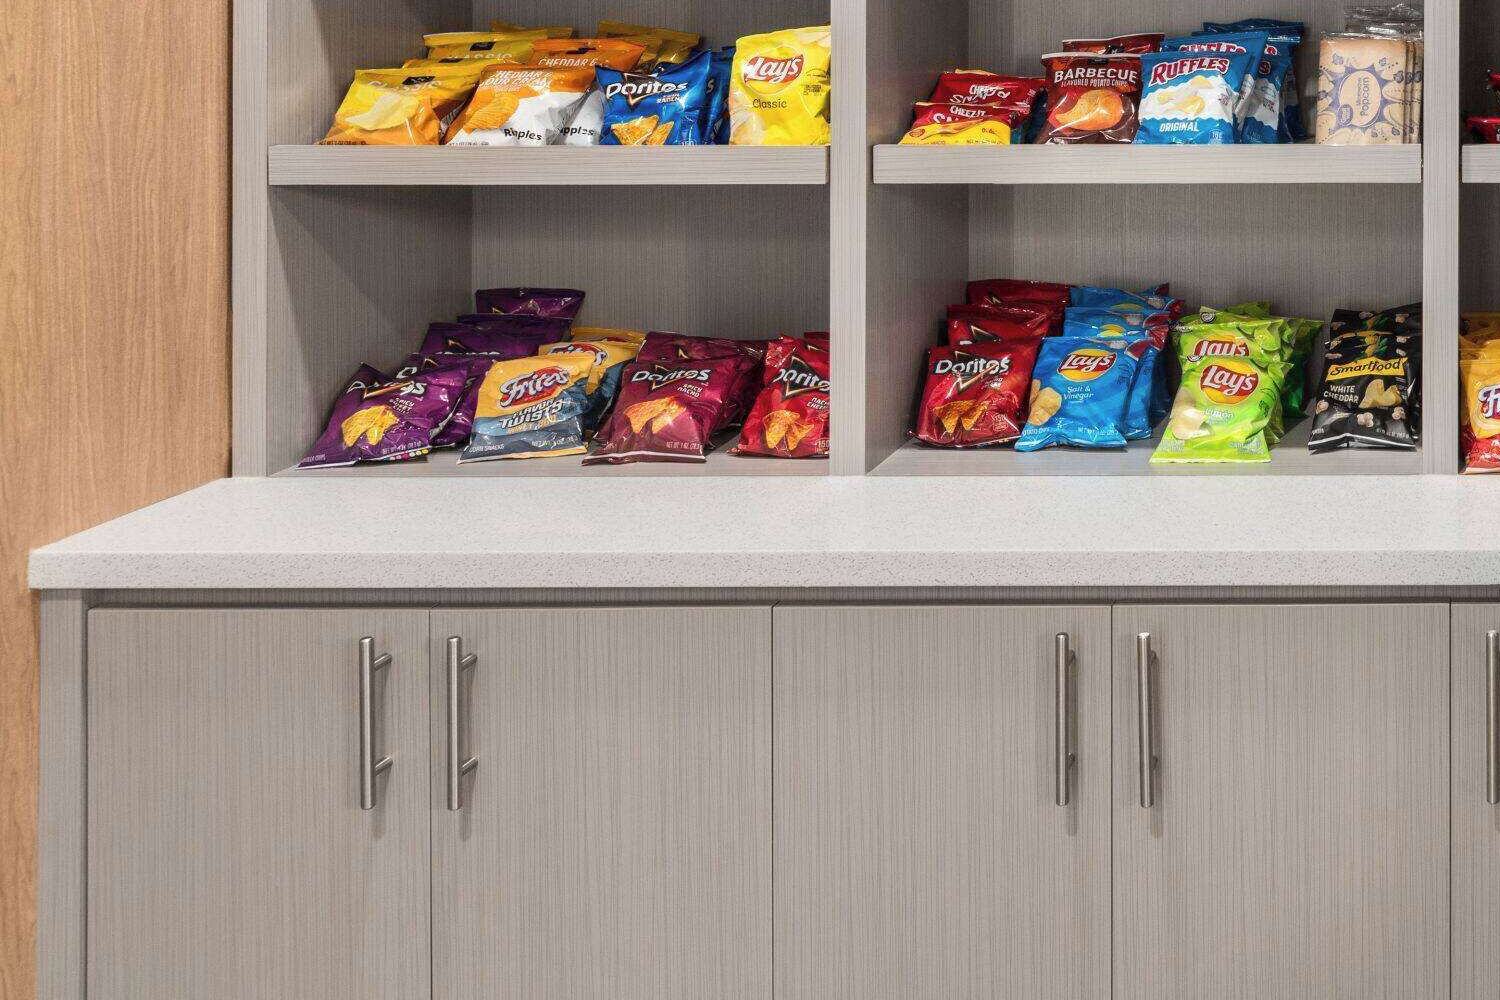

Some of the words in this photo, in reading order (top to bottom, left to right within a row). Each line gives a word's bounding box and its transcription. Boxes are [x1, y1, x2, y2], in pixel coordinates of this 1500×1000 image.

[1054, 67, 1138, 84] BARBECUE
[1149, 58, 1229, 87] RUFFLES
[607, 79, 688, 100] Doritos
[1360, 77, 1370, 116] Popcorn
[752, 98, 788, 110] Classic
[1159, 122, 1200, 133] ORIGINAL
[934, 357, 1010, 376] Doritos
[1061, 352, 1112, 373] Lay's
[1330, 360, 1402, 377] Smartfood
[631, 368, 711, 383] Doritos
[1203, 365, 1254, 396] Lay's
[500, 369, 568, 407] Fritos
[677, 386, 702, 398] NACHO
[1330, 384, 1355, 394] WHITE
[1323, 391, 1359, 404] CHEDDAR
